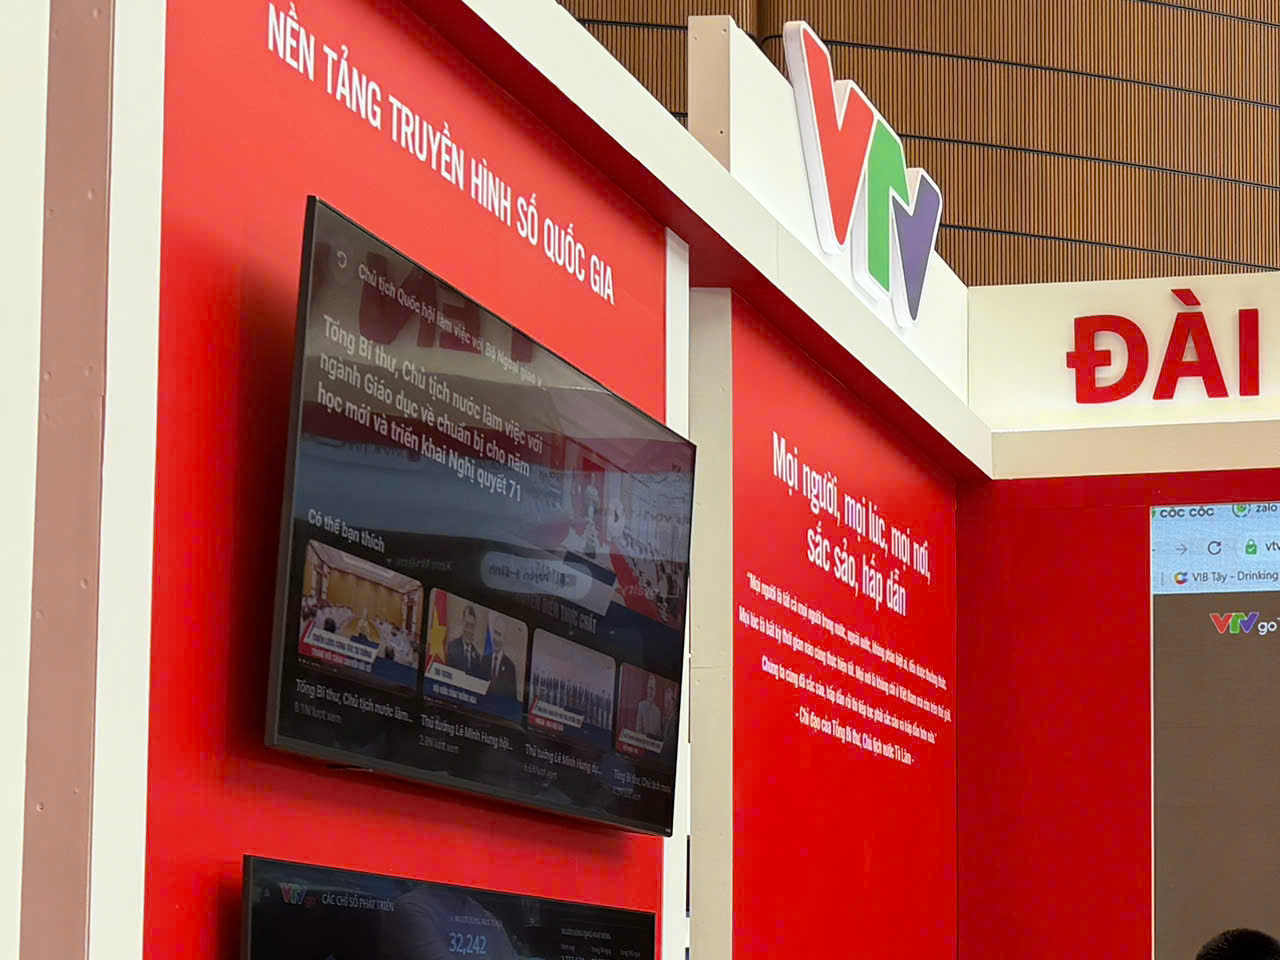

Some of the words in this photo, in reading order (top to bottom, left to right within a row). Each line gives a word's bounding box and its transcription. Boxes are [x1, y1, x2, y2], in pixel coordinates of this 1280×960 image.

[268, 2, 315, 81] NỀN
[323, 45, 382, 131] TẢNG
[389, 95, 465, 190] TRUYỀN
[471, 157, 512, 228] HÌNH
[516, 193, 538, 247] SỐ
[543, 218, 586, 282] QUỐC
[590, 252, 615, 305] GIA
[793, 22, 943, 328] VTV
[324, 314, 355, 355] Tổng
[359, 336, 372, 360] Bí
[375, 345, 398, 378] thư,
[402, 361, 426, 390] Chủ
[429, 376, 450, 403] tịch
[452, 392, 480, 419] nước
[483, 404, 502, 432] làm
[505, 420, 526, 445] việc
[527, 434, 543, 454] với
[1066, 288, 1260, 404] ĐÀI
[318, 381, 342, 413] học
[345, 401, 370, 427] mới
[374, 414, 388, 436] và
[391, 421, 418, 451] triển
[421, 434, 446, 464] khai
[449, 449, 475, 483] Nghị
[477, 468, 506, 495] quyết
[508, 480, 520, 502] 71
[320, 353, 360, 388] ngành
[364, 373, 392, 404] Giáo
[396, 390, 418, 418] dục
[421, 404, 434, 426] về
[437, 414, 470, 446] chuẩn
[473, 430, 484, 456] bị
[486, 440, 505, 464] cho
[508, 452, 529, 476] năm
[308, 509, 322, 527] Có
[342, 522, 359, 543] bạn
[362, 531, 384, 552] thích
[773, 432, 798, 496] Mọi
[803, 464, 840, 525] người,
[844, 494, 866, 541] mọi
[869, 501, 888, 556] lúc,
[892, 527, 910, 569] mọi
[913, 541, 930, 584] nơi,
[808, 521, 830, 571] sắc
[834, 538, 860, 596] sảo,
[862, 554, 883, 610] hấp
[885, 567, 906, 616] dẫn
[1256, 502, 1278, 513] zalo
